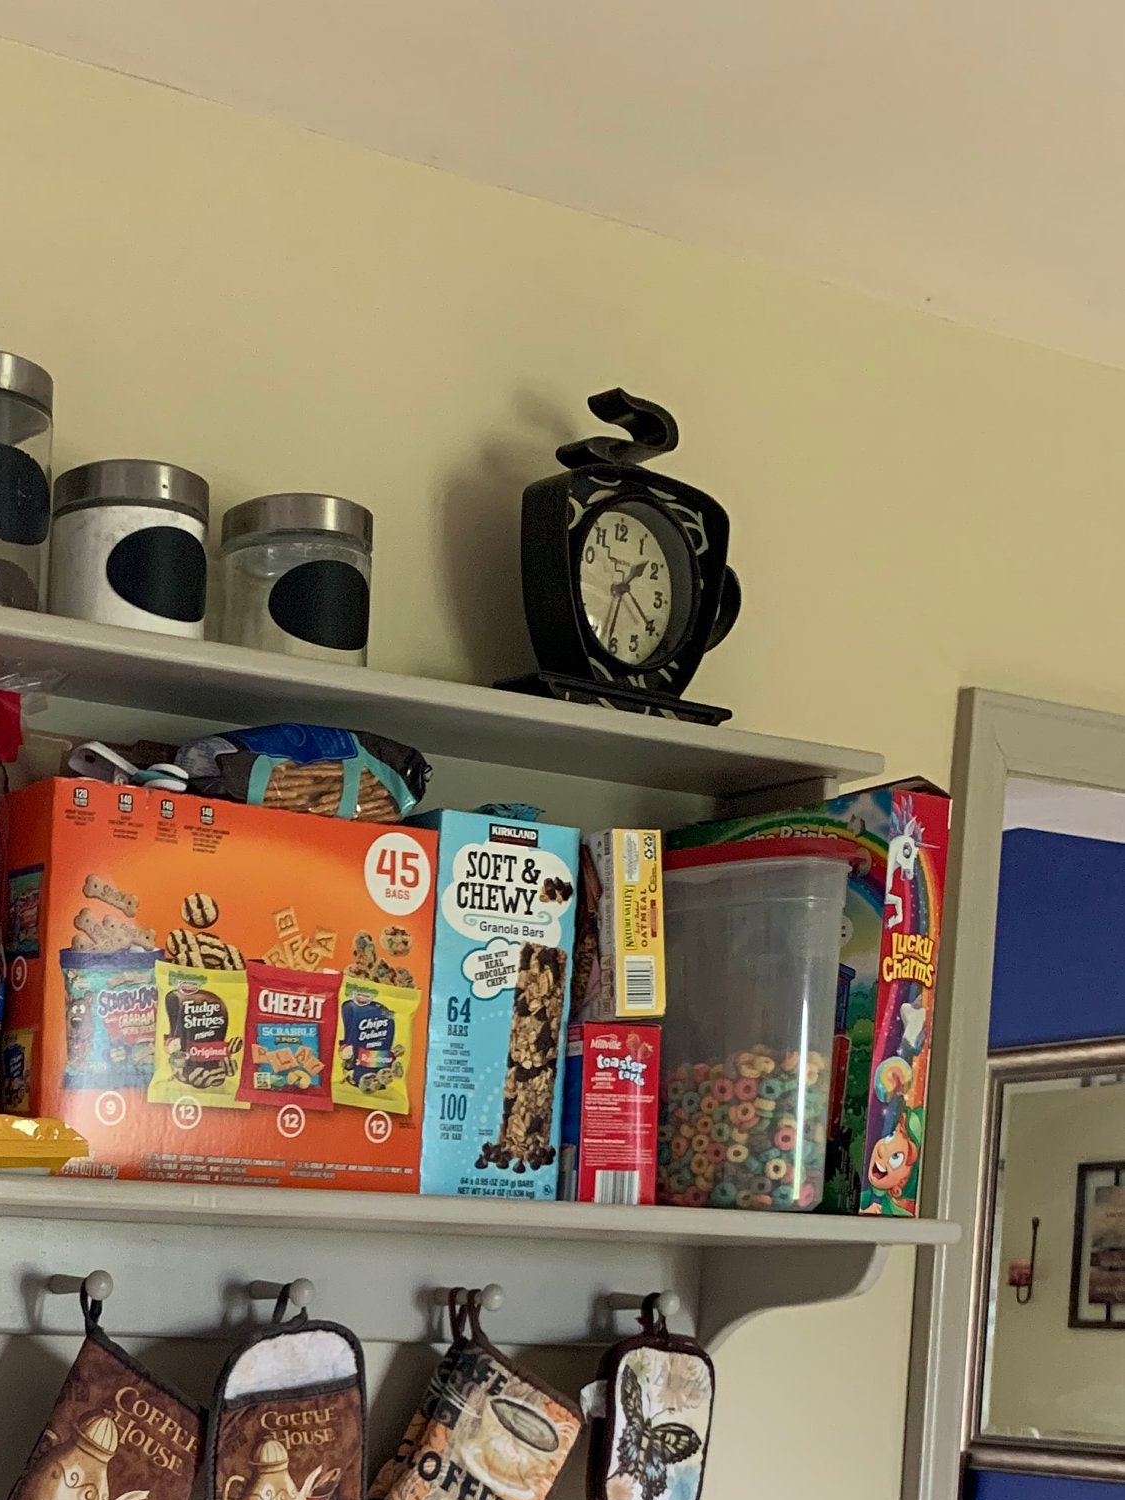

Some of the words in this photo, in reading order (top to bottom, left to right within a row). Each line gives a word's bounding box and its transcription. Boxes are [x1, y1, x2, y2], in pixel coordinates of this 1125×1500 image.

[614, 522, 629, 543] 12
[639, 538, 645, 556] 1
[649, 562, 659, 580] 2
[653, 591, 663, 609] 3
[645, 619, 656, 637] 4
[629, 634, 638, 652] 5
[491, 825, 537, 841] KIRKLAND
[376, 848, 421, 888] 45
[466, 851, 517, 882] SOFT
[521, 858, 541, 885] &
[385, 887, 411, 901] BAGS
[457, 882, 538, 916] CHEWY
[639, 888, 648, 948] OATMEAL
[479, 921, 519, 936] Granola
[522, 926, 544, 938] Bars
[892, 932, 934, 964] Lucky
[475, 965, 516, 981] CHOCOLATE
[485, 959, 504, 969] REAL
[883, 956, 934, 987] Charms
[486, 976, 507, 987] CHIPS
[183, 1000, 220, 1016] Fudge
[258, 989, 325, 1020] CHEEZ-IT
[447, 996, 471, 1023] 64
[184, 1015, 225, 1029] Stripes
[358, 1018, 388, 1031] Chips
[447, 1024, 469, 1037] BARS
[262, 1027, 316, 1037] SCRABBLE
[190, 1046, 227, 1058] Original
[596, 1053, 647, 1073] toaster
[179, 1106, 195, 1120] 12
[439, 1093, 467, 1121] 100
[282, 1113, 299, 1128] 12
[370, 1120, 386, 1135] 12
[115, 1386, 200, 1456] COFFEE
[260, 1405, 340, 1432] COFFEE
[111, 1411, 184, 1476] HOUSE
[264, 1427, 336, 1449] HOUSE
